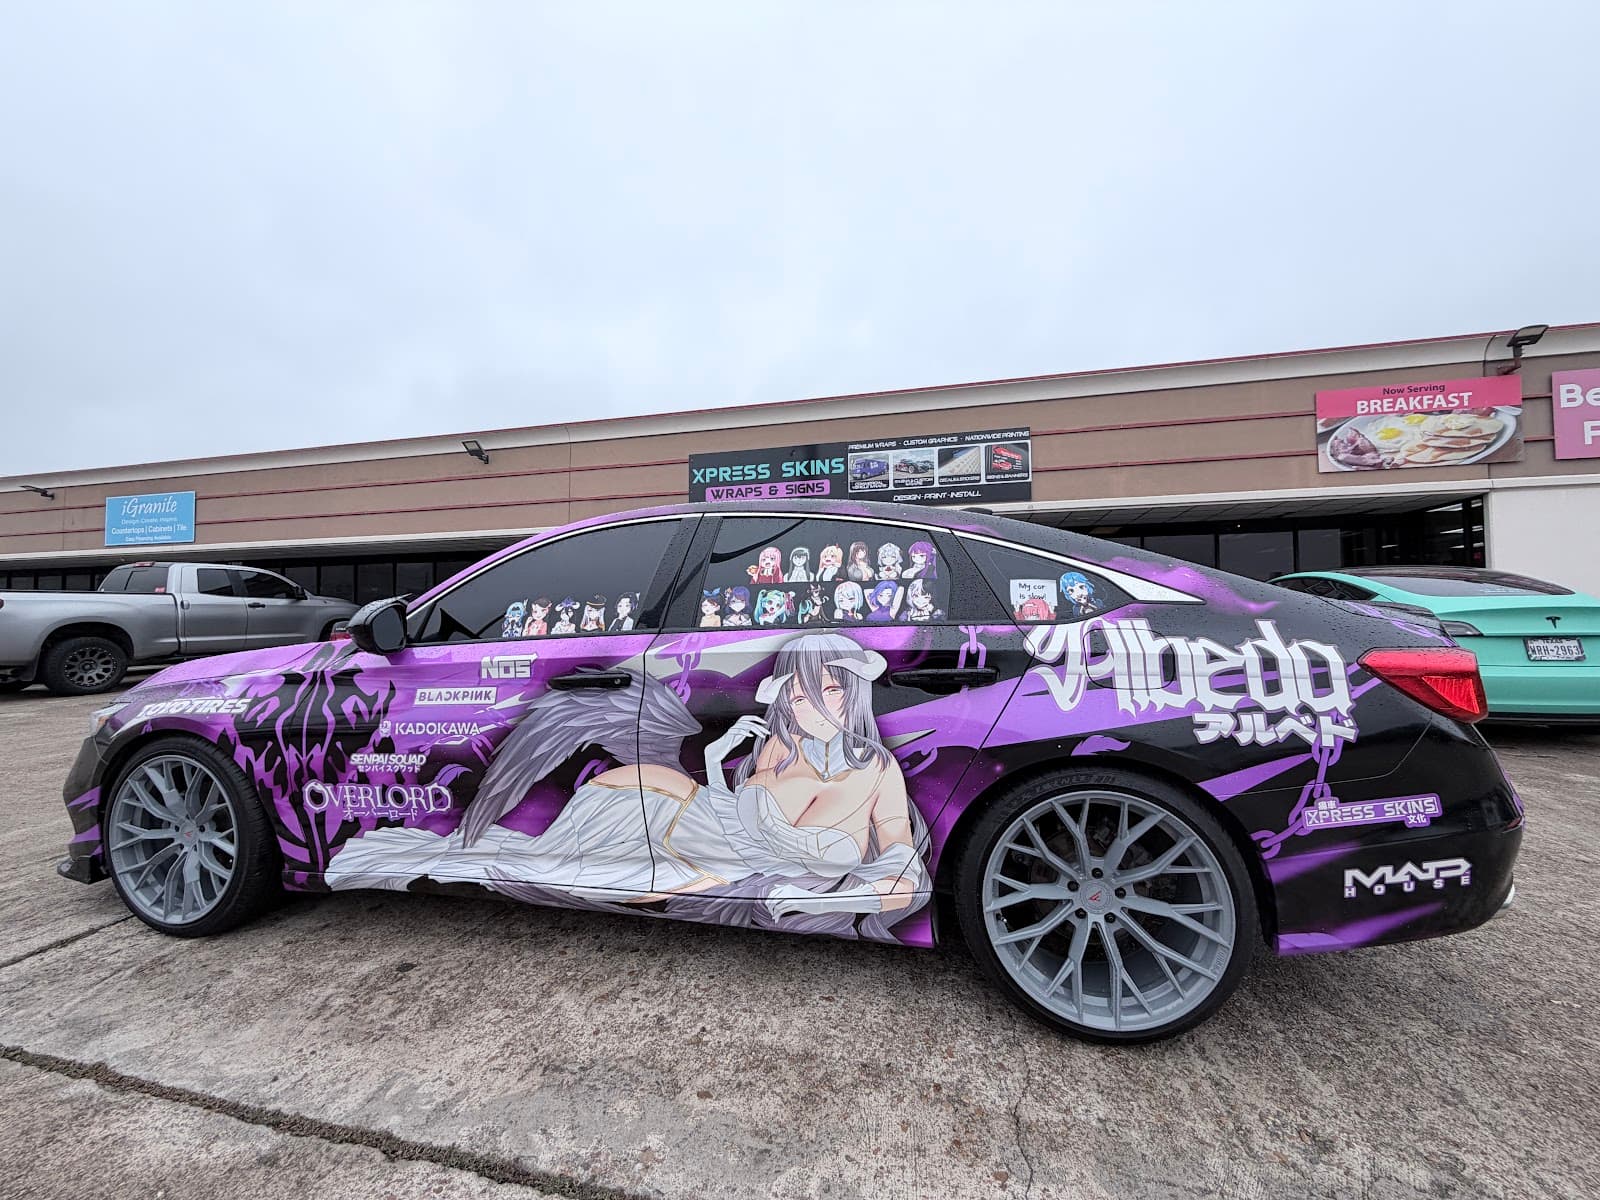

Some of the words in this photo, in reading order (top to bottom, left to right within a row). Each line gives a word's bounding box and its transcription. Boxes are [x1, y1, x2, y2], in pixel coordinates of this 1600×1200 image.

[1383, 387, 1405, 395] Now
[1407, 384, 1446, 393] Serving
[1356, 391, 1473, 415] BREAKFAST
[848, 442, 874, 450] PREMIUM
[874, 440, 897, 449] WRAPS
[903, 438, 927, 446] CUSTOM
[928, 436, 958, 444] GRAPHICS
[964, 432, 1002, 441] NATIONWIDE
[1001, 430, 1030, 439] PRINTING
[692, 463, 771, 484] XPRESS
[781, 457, 845, 478] SKINS
[710, 486, 763, 500] WRAPS
[768, 485, 779, 496] &
[785, 482, 825, 495] SIGNS
[121, 496, 177, 517] iGranite
[111, 526, 145, 535] Countertops
[148, 525, 173, 533] Cabinets
[1018, 582, 1031, 591] My
[481, 653, 538, 680] NOS
[1023, 617, 1356, 719] Albedo
[184, 698, 252, 714] TIRES
[395, 722, 481, 735] KADOKAWA
[350, 753, 388, 765] SENPAI
[388, 753, 427, 765] SQUAD
[304, 781, 452, 814] OVERLORD
[1307, 804, 1376, 825] XPRESS
[1383, 798, 1436, 817] SKINS
[1407, 813, 1428, 824] 文化
[1343, 874, 1471, 899] HOUSE
